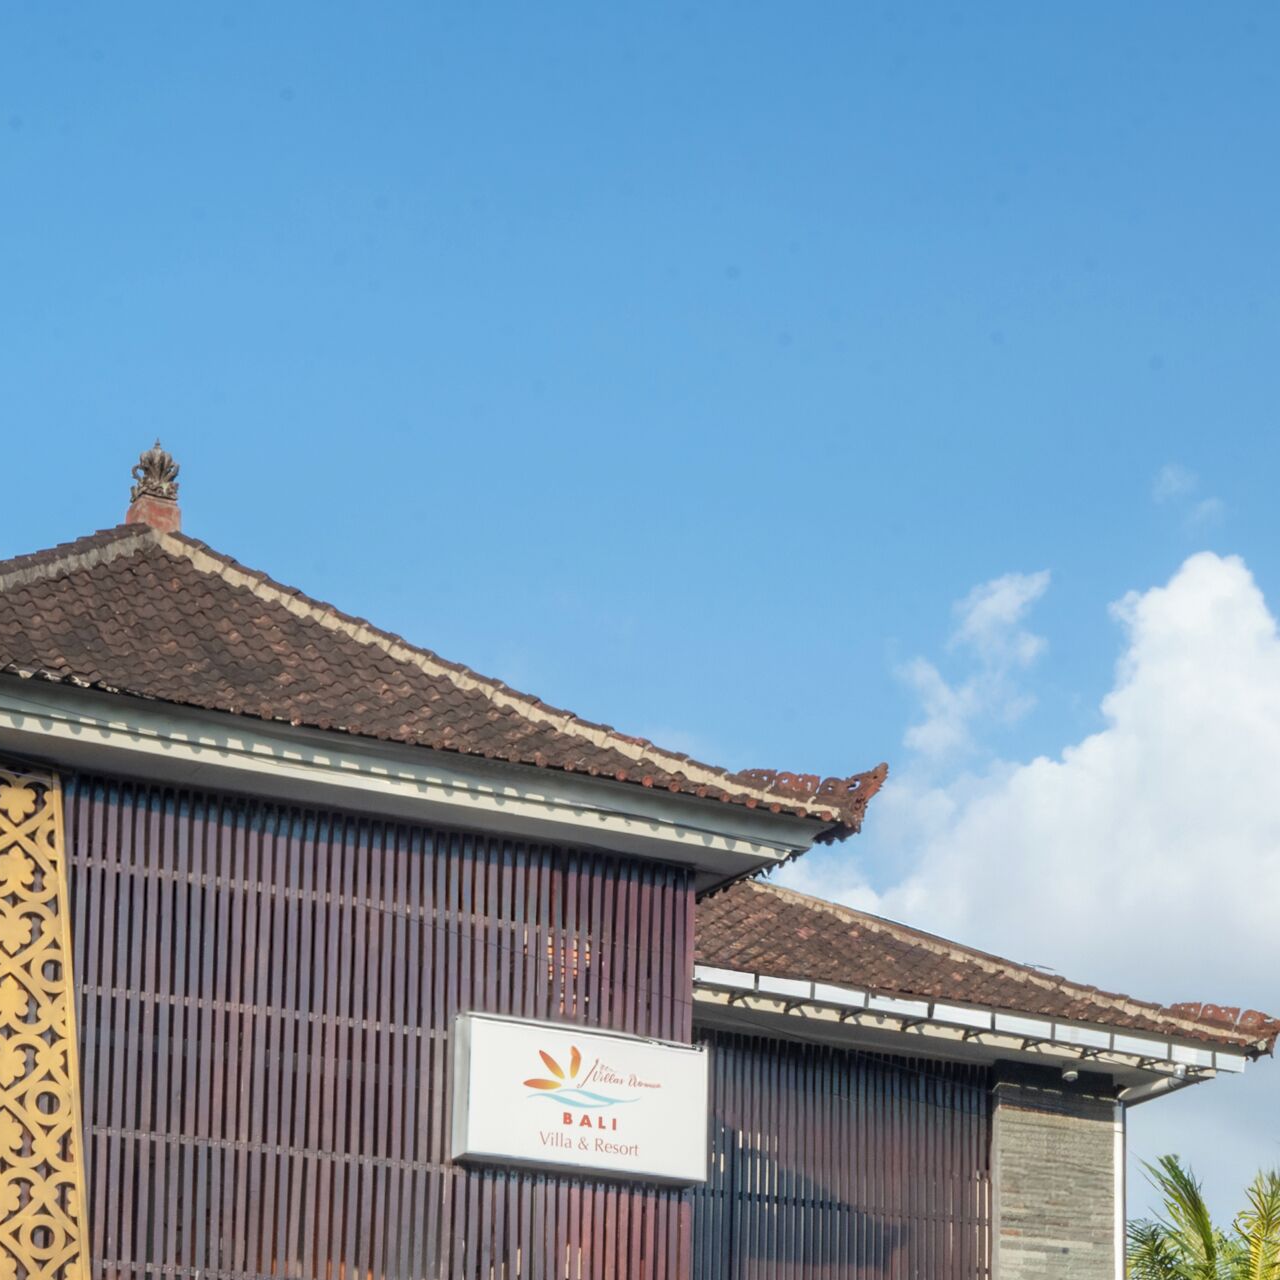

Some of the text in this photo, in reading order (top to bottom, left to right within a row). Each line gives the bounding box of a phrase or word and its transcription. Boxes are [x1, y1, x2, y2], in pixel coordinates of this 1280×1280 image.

[562, 1112, 618, 1131] BALI
[539, 1130, 640, 1157] Villa & Resort
